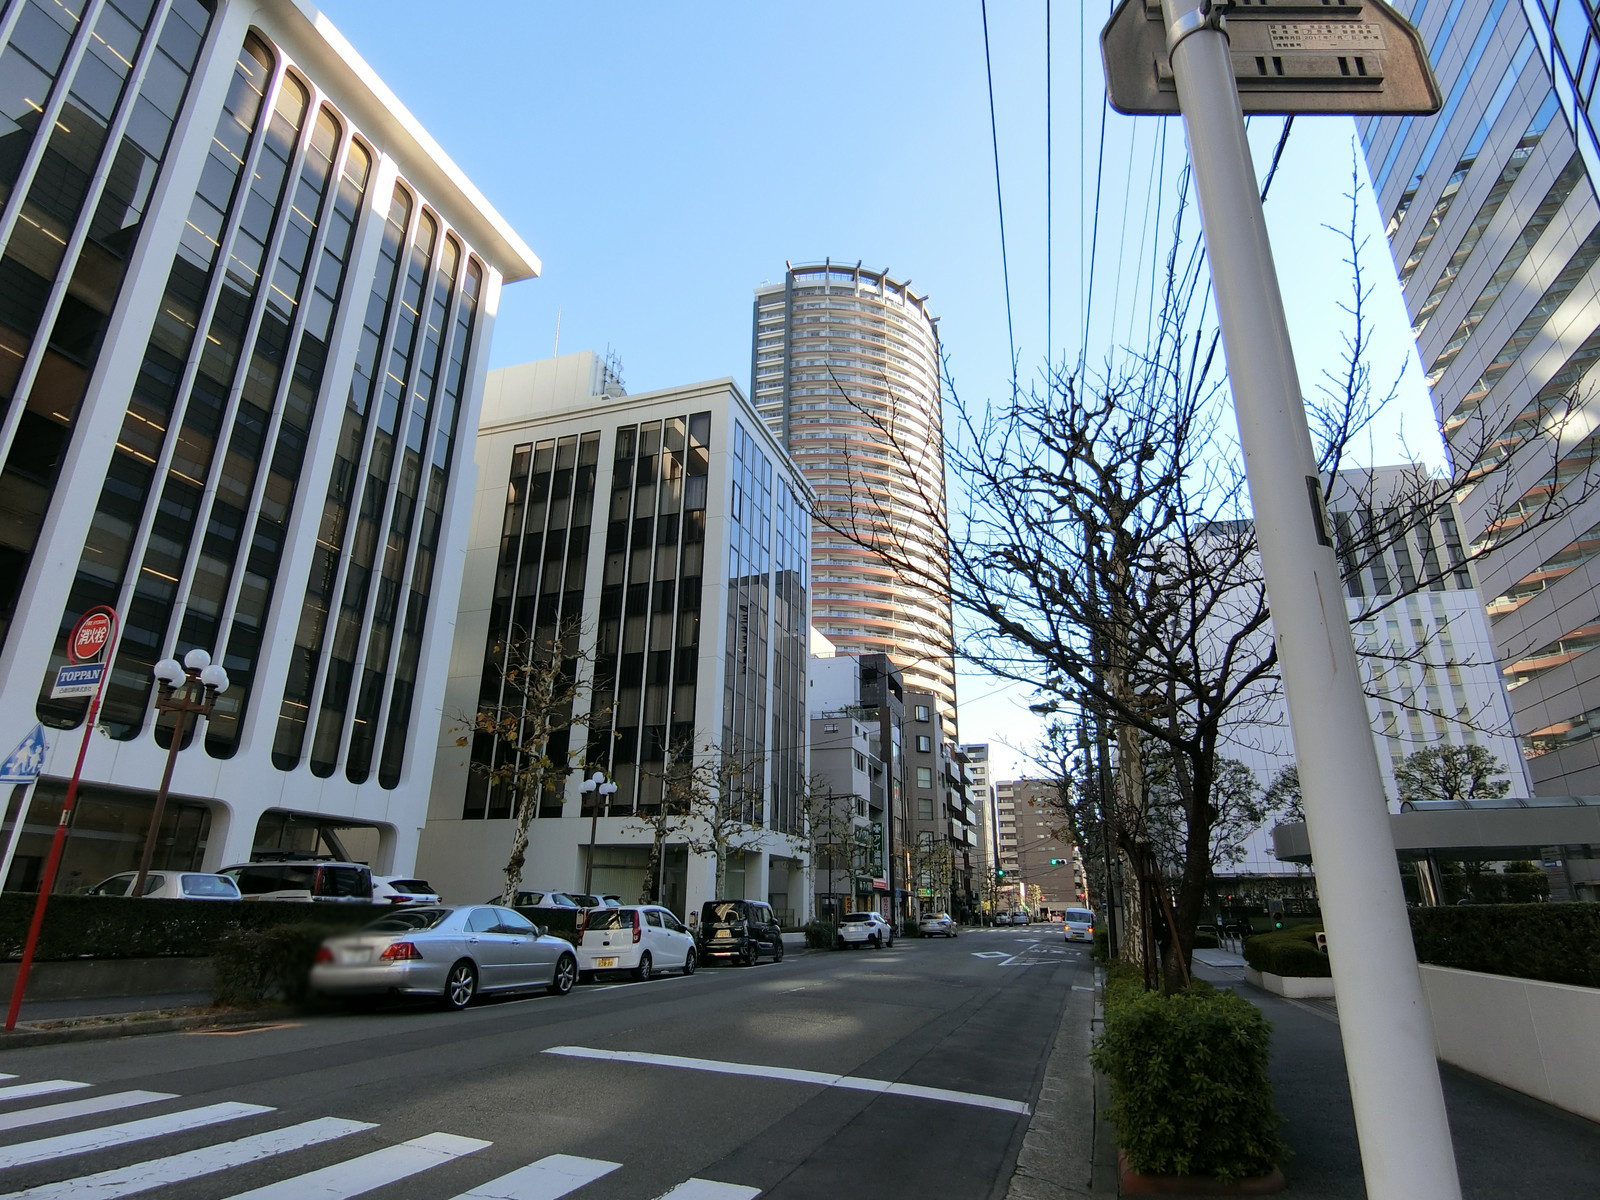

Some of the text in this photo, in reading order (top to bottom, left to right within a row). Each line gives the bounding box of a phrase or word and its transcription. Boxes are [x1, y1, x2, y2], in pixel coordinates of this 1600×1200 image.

[78, 626, 107, 645] 消火栓
[60, 669, 102, 682] TOPPAN
